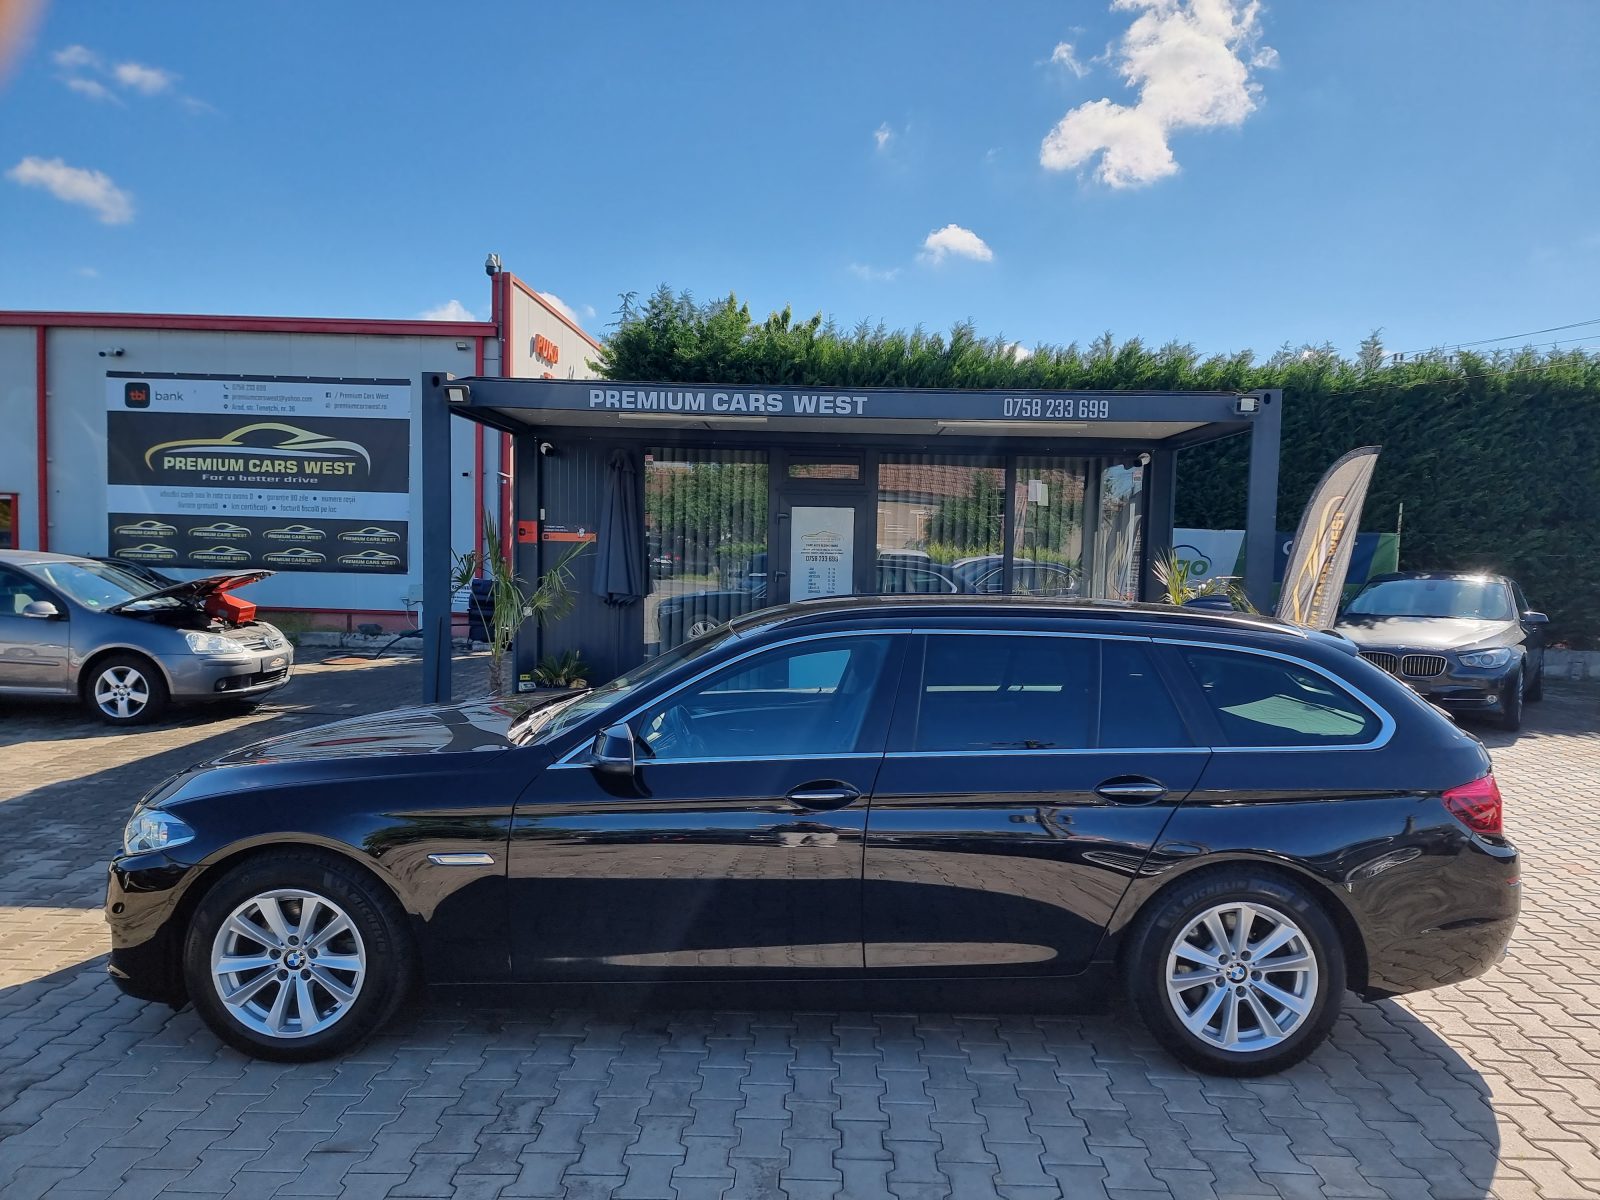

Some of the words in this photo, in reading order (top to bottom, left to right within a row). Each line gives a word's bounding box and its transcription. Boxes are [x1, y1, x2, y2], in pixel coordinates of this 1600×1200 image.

[155, 391, 184, 401] bank
[588, 389, 705, 411] PREMIUM
[712, 392, 783, 412] CARS
[792, 395, 868, 415] WEST
[1003, 398, 1041, 417] 0758
[1045, 399, 1074, 418] 233
[1078, 399, 1109, 419] 699
[163, 457, 244, 472] PREMIUM
[249, 459, 298, 474] CARS
[304, 461, 356, 475] WEST
[240, 474, 279, 483] better
[1182, 880, 1247, 907] MICHELIN
